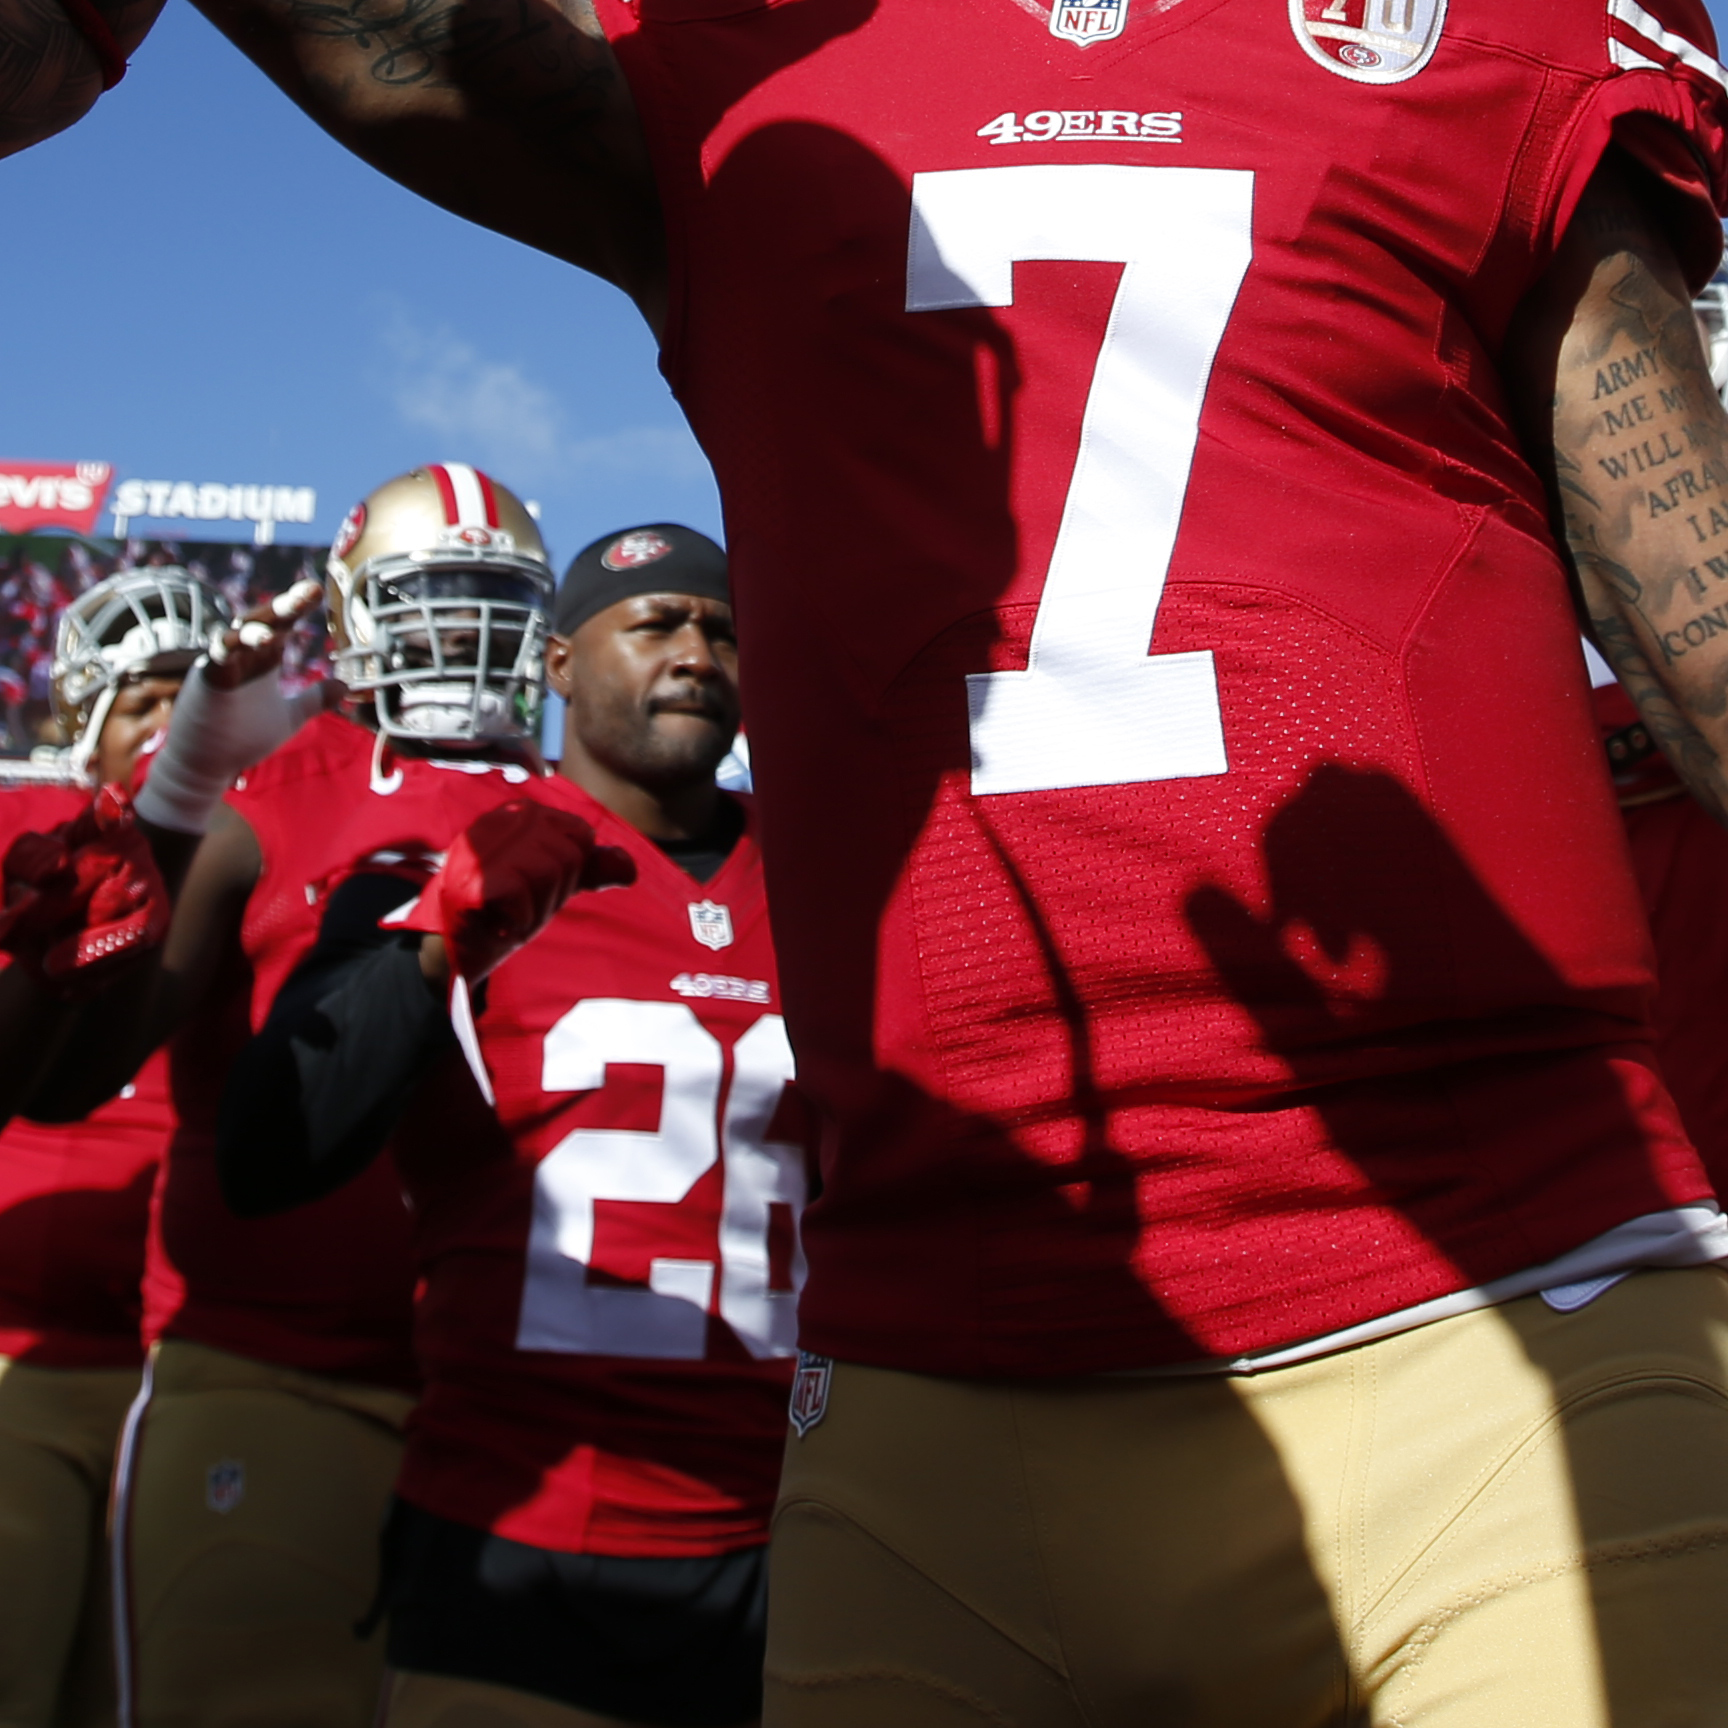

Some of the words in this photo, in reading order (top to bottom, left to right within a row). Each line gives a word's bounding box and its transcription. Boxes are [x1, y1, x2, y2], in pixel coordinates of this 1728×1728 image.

[1063, 9, 1112, 33] NFL
[976, 110, 1183, 144] 49ERS
[1591, 346, 1661, 400] ARMY
[1604, 394, 1653, 437] ME
[1599, 433, 1683, 482] WILL
[115, 477, 316, 524] STADIUM
[904, 164, 1255, 796] 7
[1686, 514, 1707, 544] I
[1688, 566, 1708, 596] I
